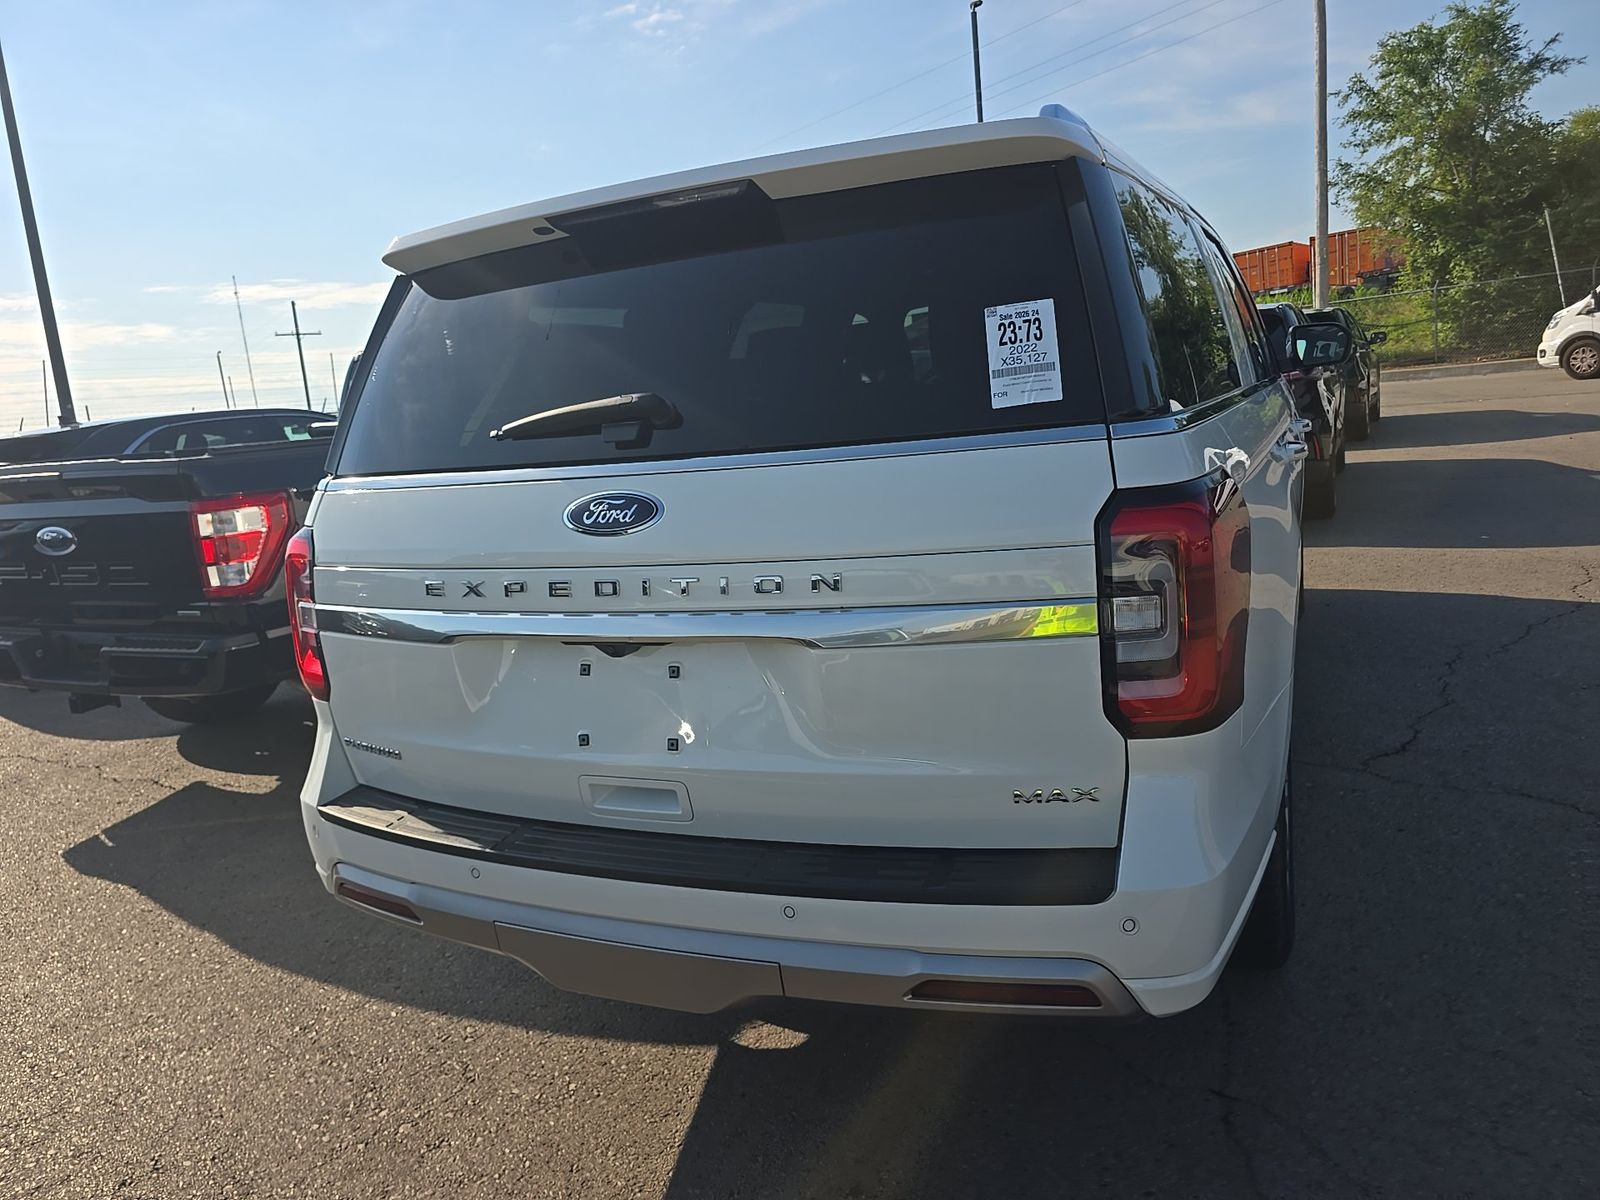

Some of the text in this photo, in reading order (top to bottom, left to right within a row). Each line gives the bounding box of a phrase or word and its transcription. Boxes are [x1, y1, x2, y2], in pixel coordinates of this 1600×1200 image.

[999, 313, 1013, 321] Sale
[1031, 309, 1040, 317] 24
[997, 317, 1043, 347] 23:73
[1009, 343, 1038, 356] 2022
[1001, 352, 1048, 367] X35,127
[993, 391, 1008, 399] FOR
[583, 499, 638, 525] Ford
[424, 572, 843, 598] EXPEDITION
[1012, 786, 1100, 804] MAX
